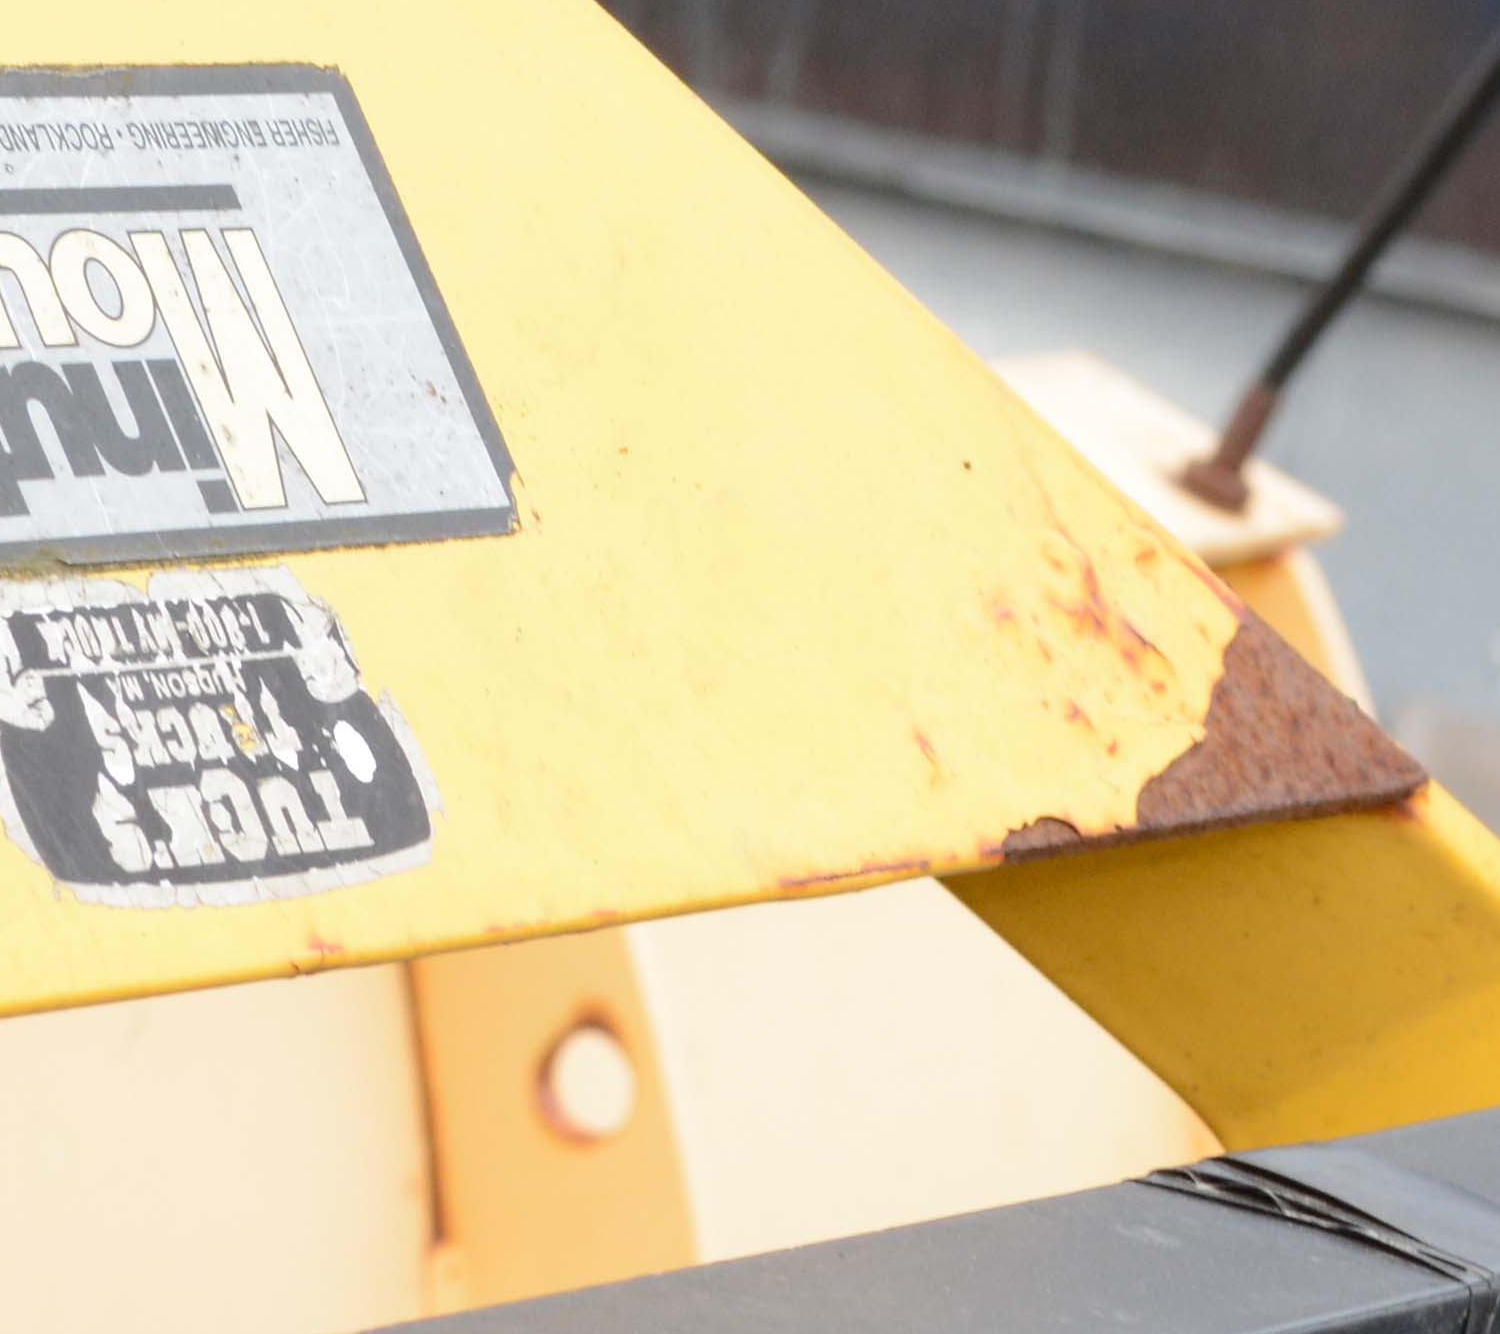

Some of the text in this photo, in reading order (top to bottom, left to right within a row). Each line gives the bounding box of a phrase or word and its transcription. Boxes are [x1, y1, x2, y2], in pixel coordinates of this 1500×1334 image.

[127, 119, 268, 150] ENGINEERING
[265, 118, 341, 147] FISHER
[86, 697, 304, 775] TRUCKS
[93, 769, 374, 873] TUCK'S
